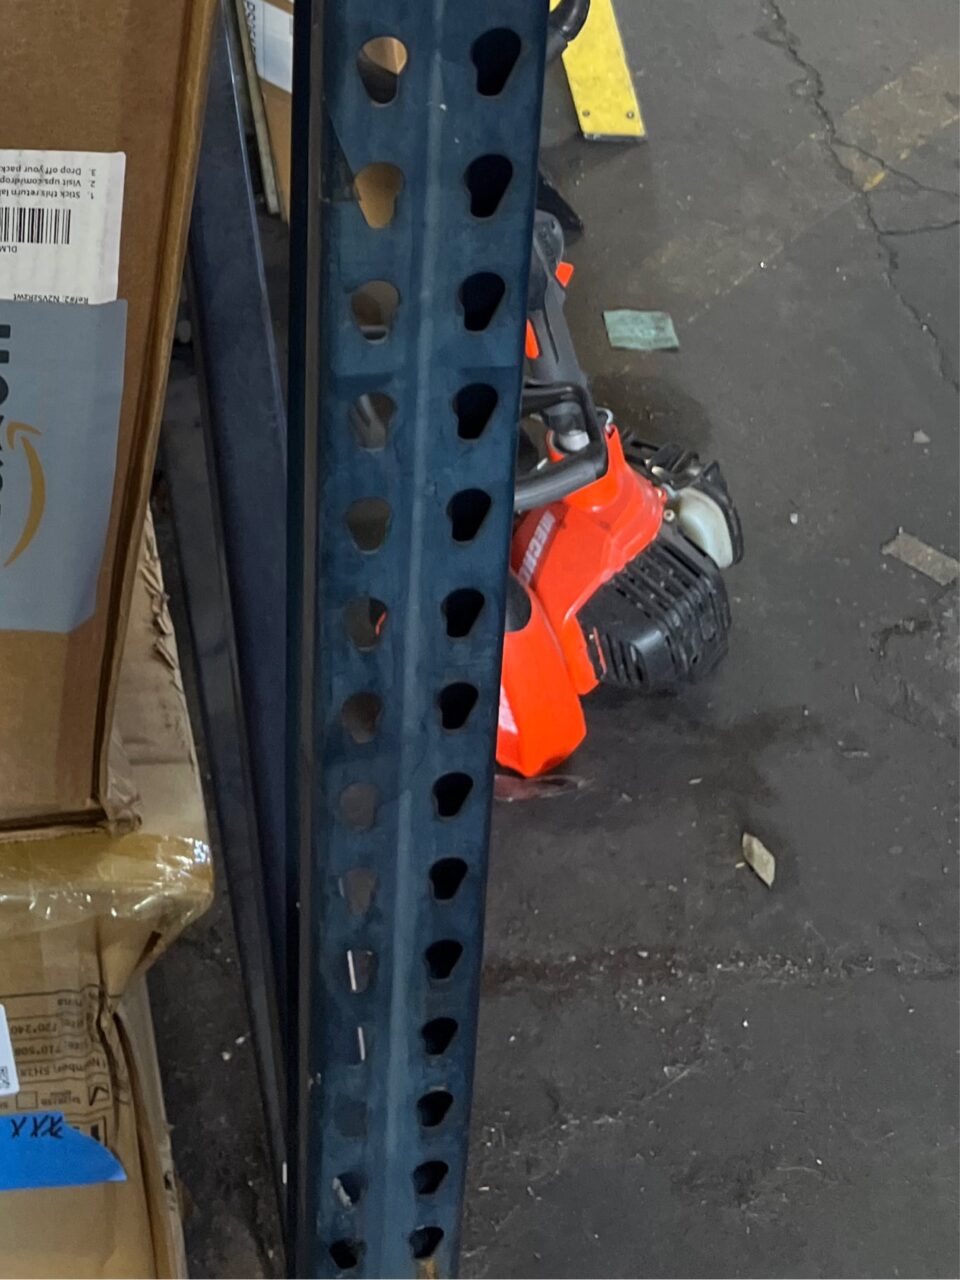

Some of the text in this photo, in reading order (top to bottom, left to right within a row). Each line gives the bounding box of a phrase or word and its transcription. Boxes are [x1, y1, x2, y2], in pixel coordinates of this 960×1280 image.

[23, 164, 43, 174] your
[44, 166, 58, 175] off
[60, 165, 82, 175] Drop
[62, 178, 81, 187] Visit
[10, 189, 39, 198] return
[41, 189, 58, 199] this
[60, 189, 81, 199] Stick
